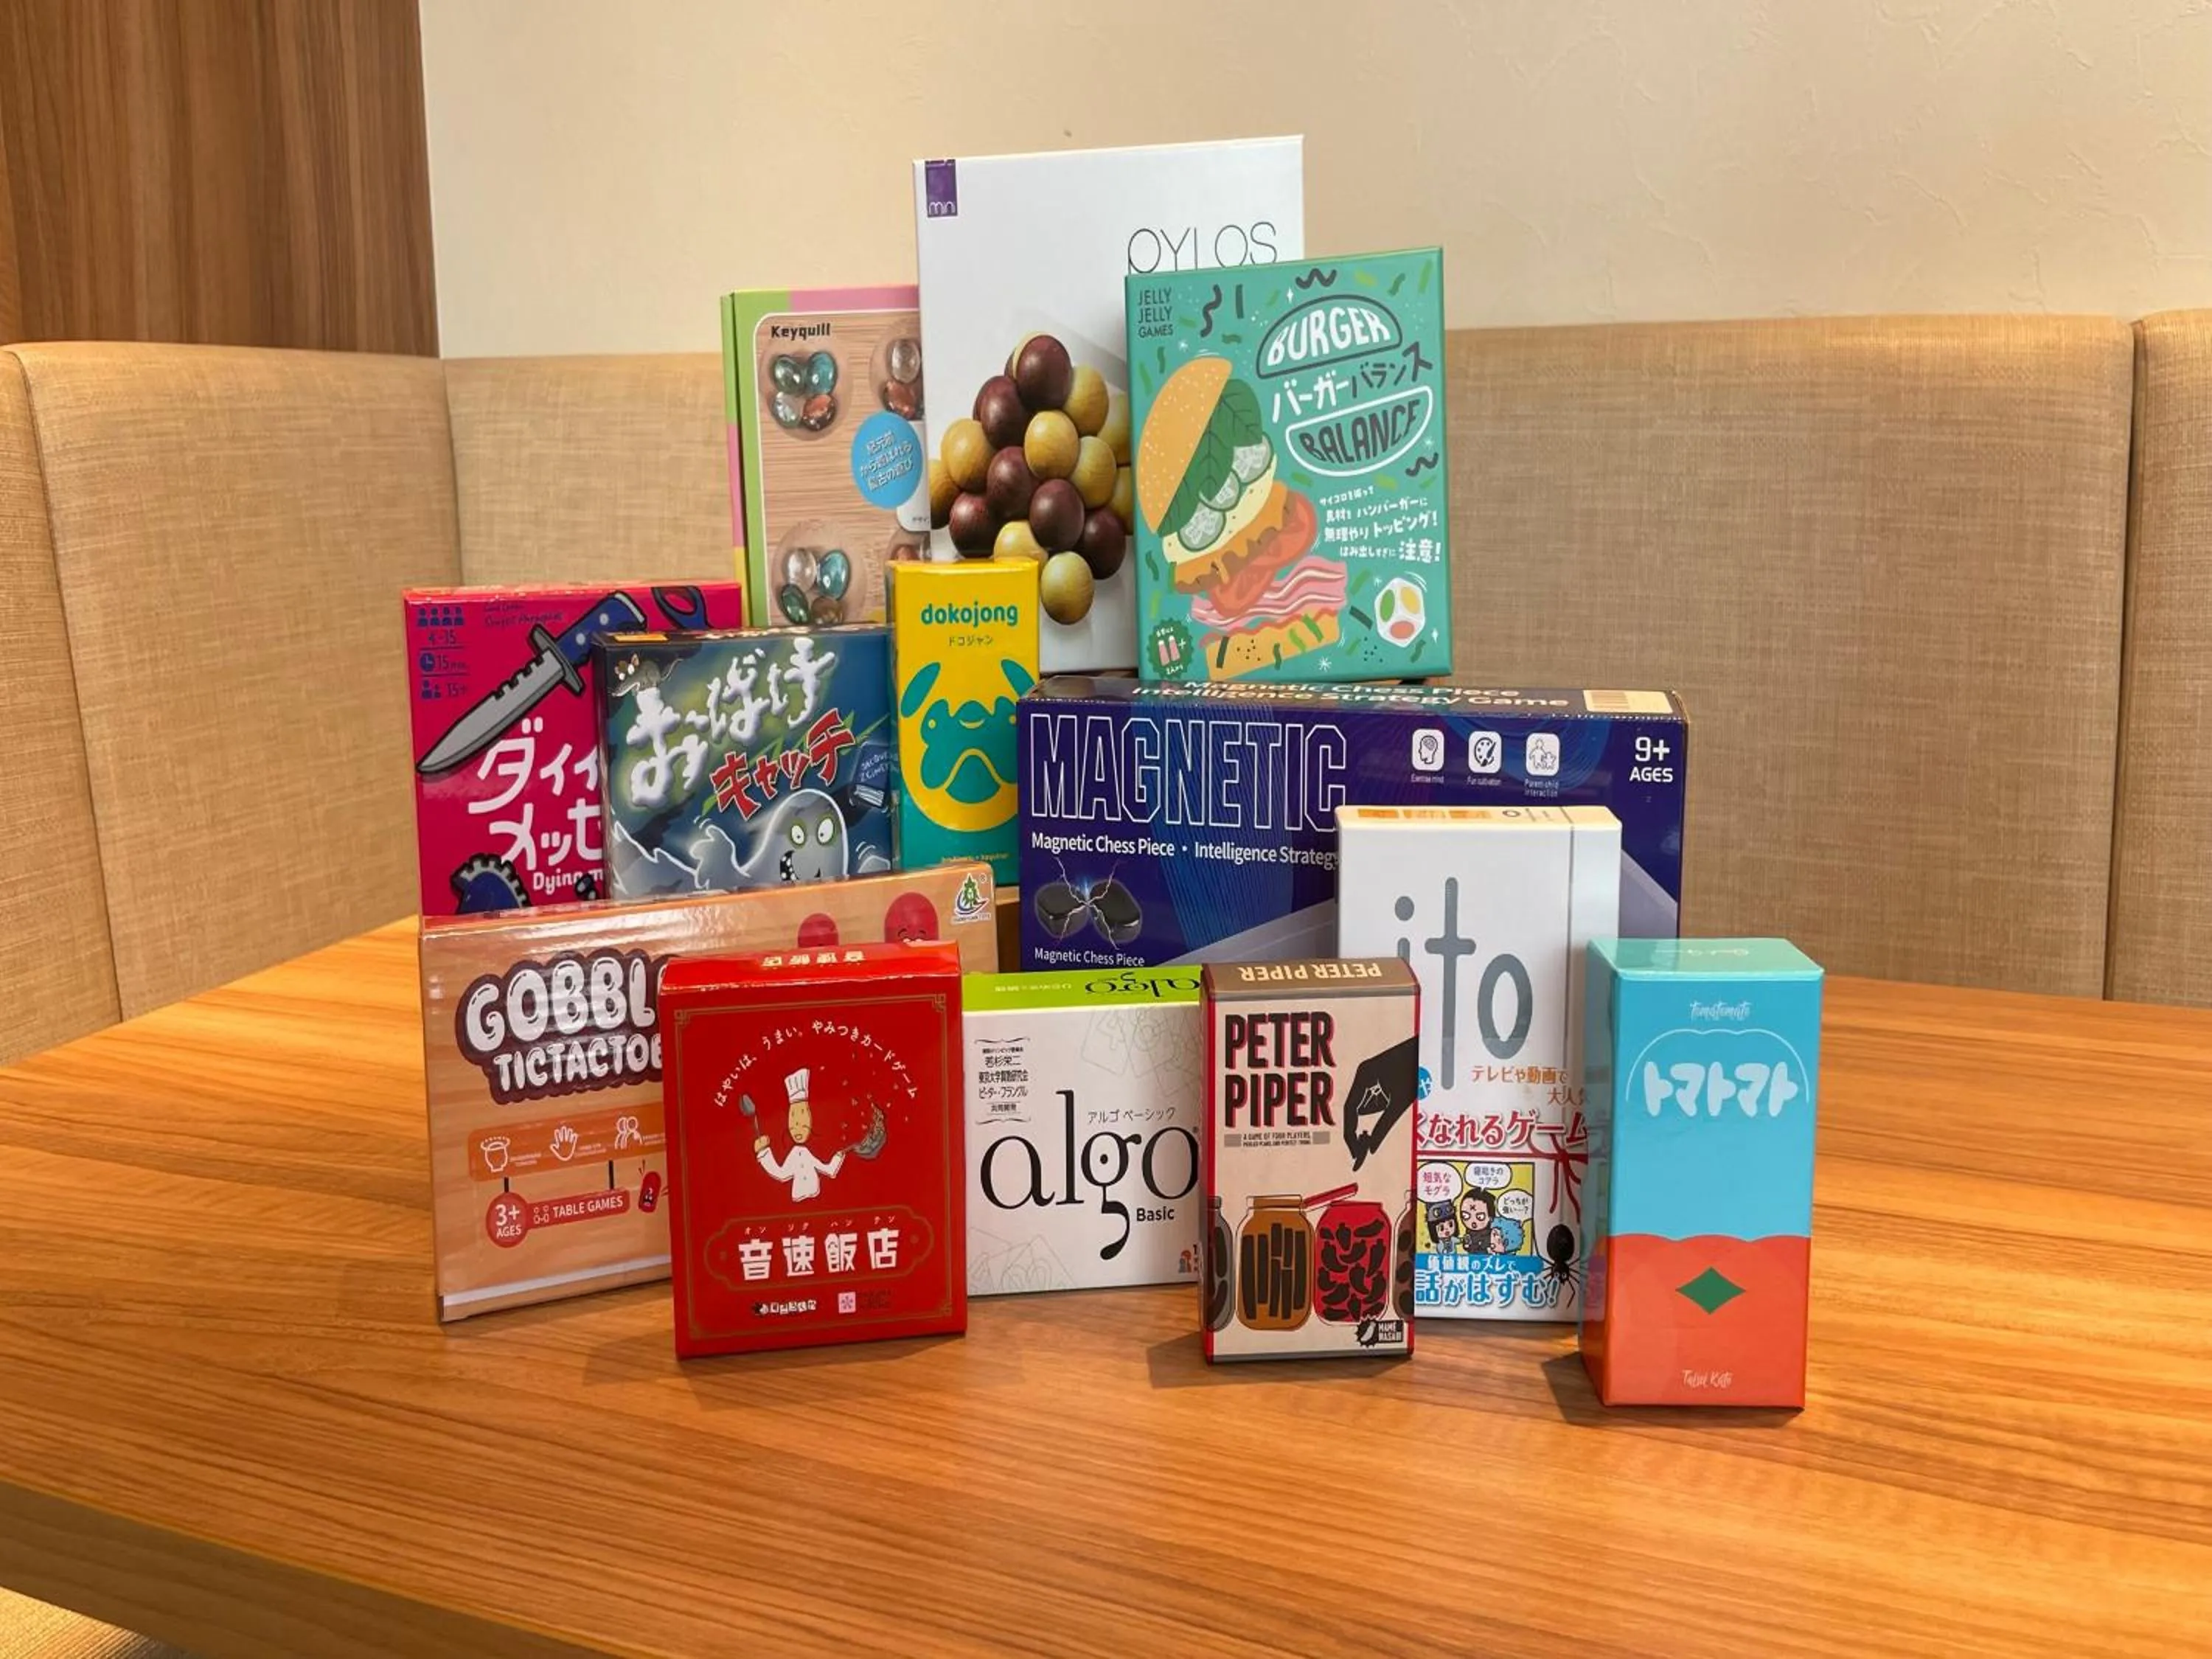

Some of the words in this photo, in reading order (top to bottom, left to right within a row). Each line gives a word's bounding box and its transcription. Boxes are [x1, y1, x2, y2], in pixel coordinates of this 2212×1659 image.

[1137, 287, 1172, 307] JELLY
[1138, 306, 1172, 324] JELLY
[1138, 324, 1174, 339] GAMES
[1267, 306, 1391, 366] BURGER
[1300, 398, 1421, 465] BALANCE
[920, 601, 1018, 627] dokojong
[948, 635, 994, 647] ドコジャン
[1634, 736, 1671, 762] 9+
[709, 708, 856, 821] キャッチ
[1030, 712, 1347, 832] MAGNETIC
[1630, 766, 1674, 783] AGES
[1032, 832, 1094, 855] Magnetic
[1095, 836, 1136, 855] Chess
[1138, 838, 1175, 858] Piece
[1194, 841, 1277, 866] Intelligence
[1034, 947, 1082, 965] Magnetic
[1083, 950, 1115, 966] Chess
[1116, 951, 1145, 967] Piece
[465, 956, 667, 1052] GOBBL
[1225, 1011, 1338, 1069] PETER
[493, 1032, 663, 1092] TICTACTOE
[1471, 1065, 1568, 1085] テレビや動画で
[1225, 1071, 1337, 1129] PIPER
[1643, 1060, 1799, 1118] トマトマト
[1087, 1108, 1119, 1124] アルゴ
[1123, 1107, 1176, 1121] ベーシック
[980, 1089, 1199, 1260] algo
[495, 1203, 521, 1227] 3+
[552, 1203, 585, 1219] TABLE
[587, 1195, 624, 1213] GAMES
[1136, 1206, 1175, 1222] Basic
[495, 1224, 522, 1239] AGES
[738, 1227, 900, 1281] 音速飯店
